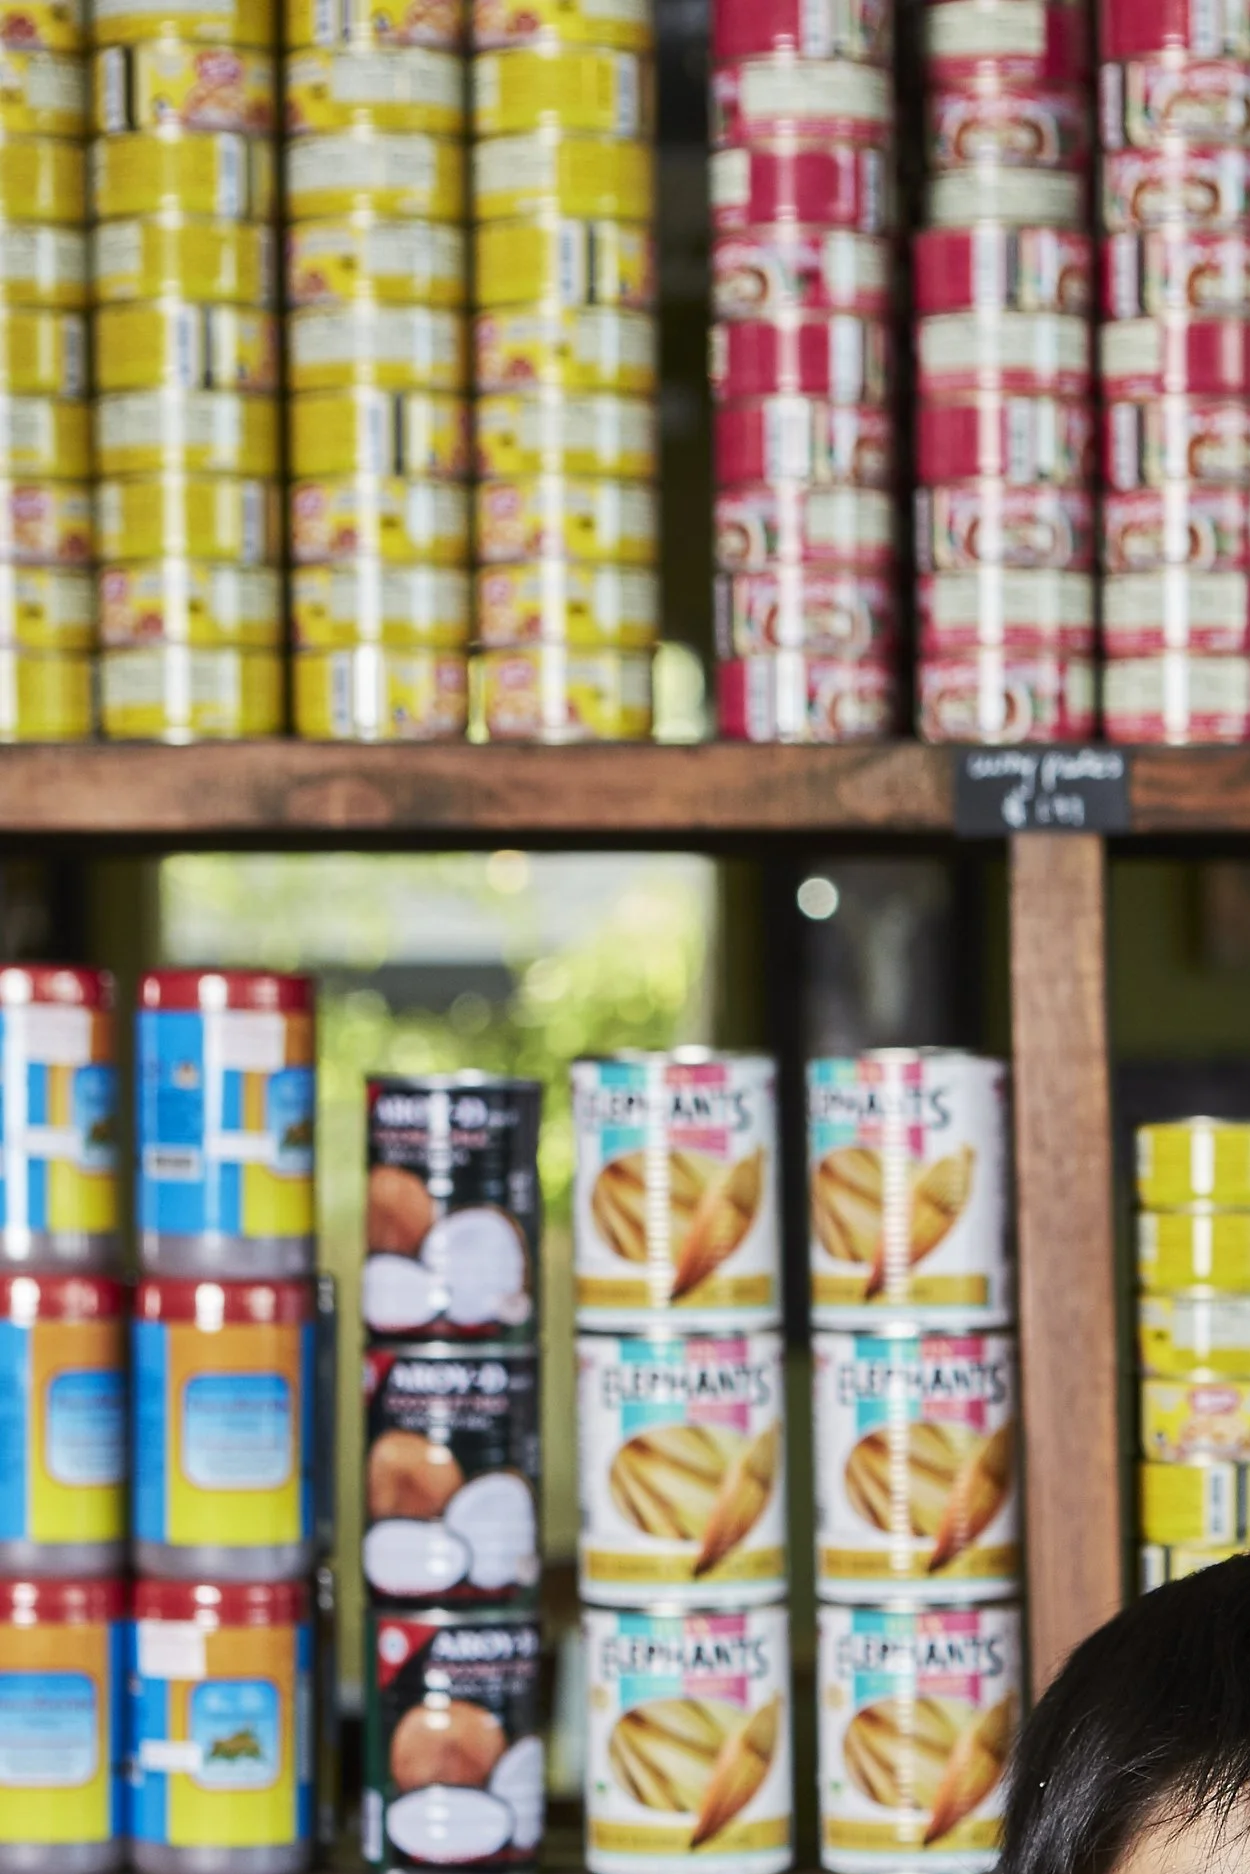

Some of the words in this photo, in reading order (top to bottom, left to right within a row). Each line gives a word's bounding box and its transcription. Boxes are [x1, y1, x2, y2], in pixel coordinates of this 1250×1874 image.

[603, 1363, 771, 1410] ELEPHANTS
[838, 1361, 1006, 1406] ELEPHANTS
[603, 1635, 769, 1680] ELEPHANTS
